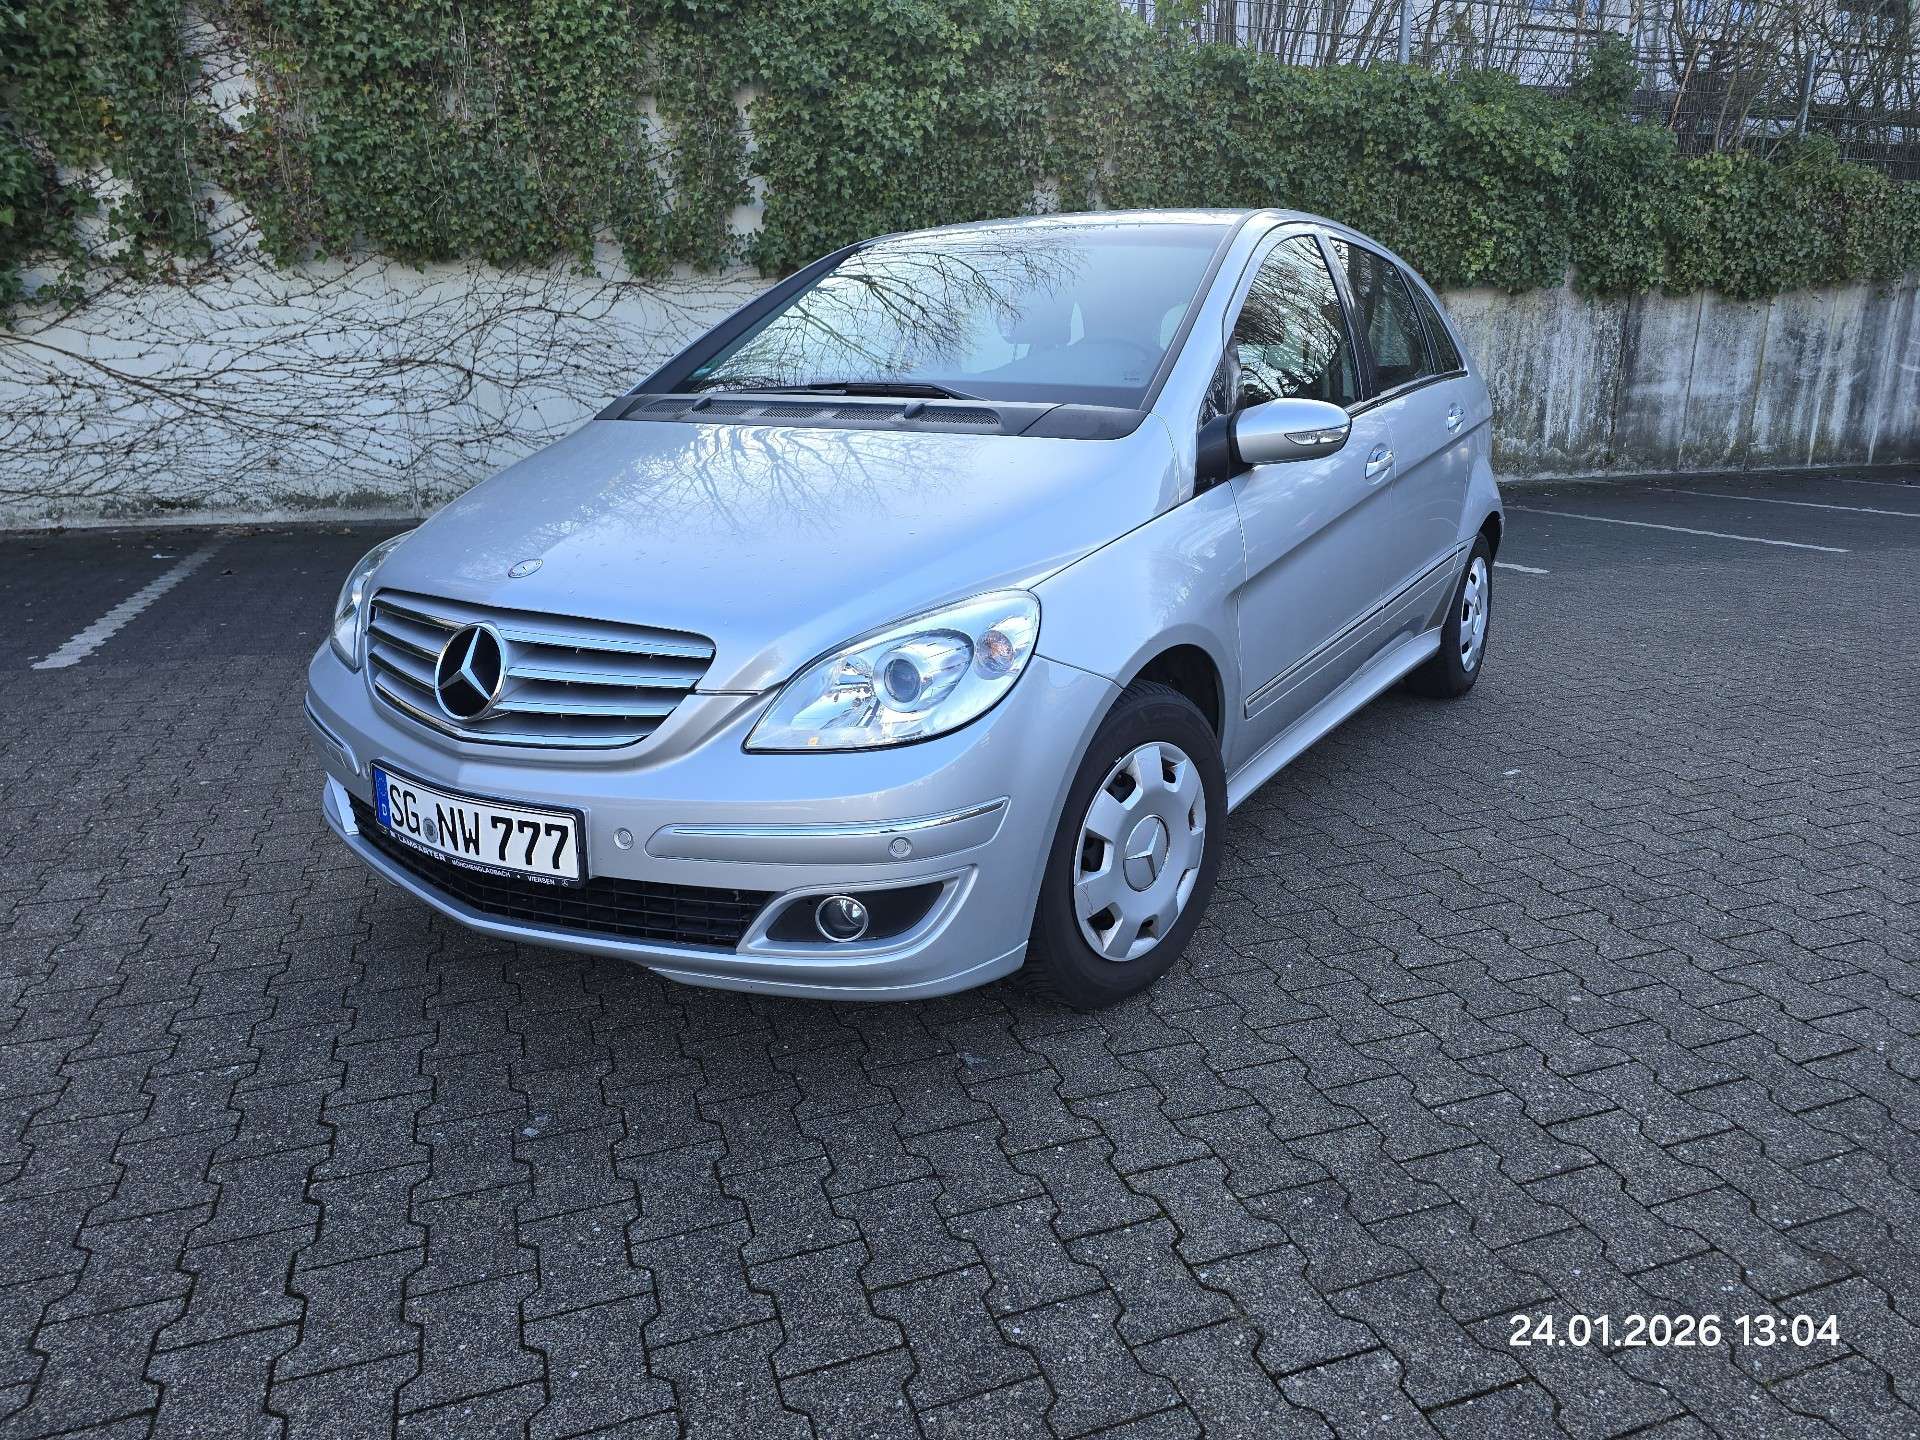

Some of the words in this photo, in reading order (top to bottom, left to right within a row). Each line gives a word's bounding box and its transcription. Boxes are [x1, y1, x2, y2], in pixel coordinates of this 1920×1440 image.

[390, 784, 421, 836] SG
[435, 803, 480, 856] NW
[491, 815, 569, 870] 777
[527, 875, 556, 886] VIERSEN
